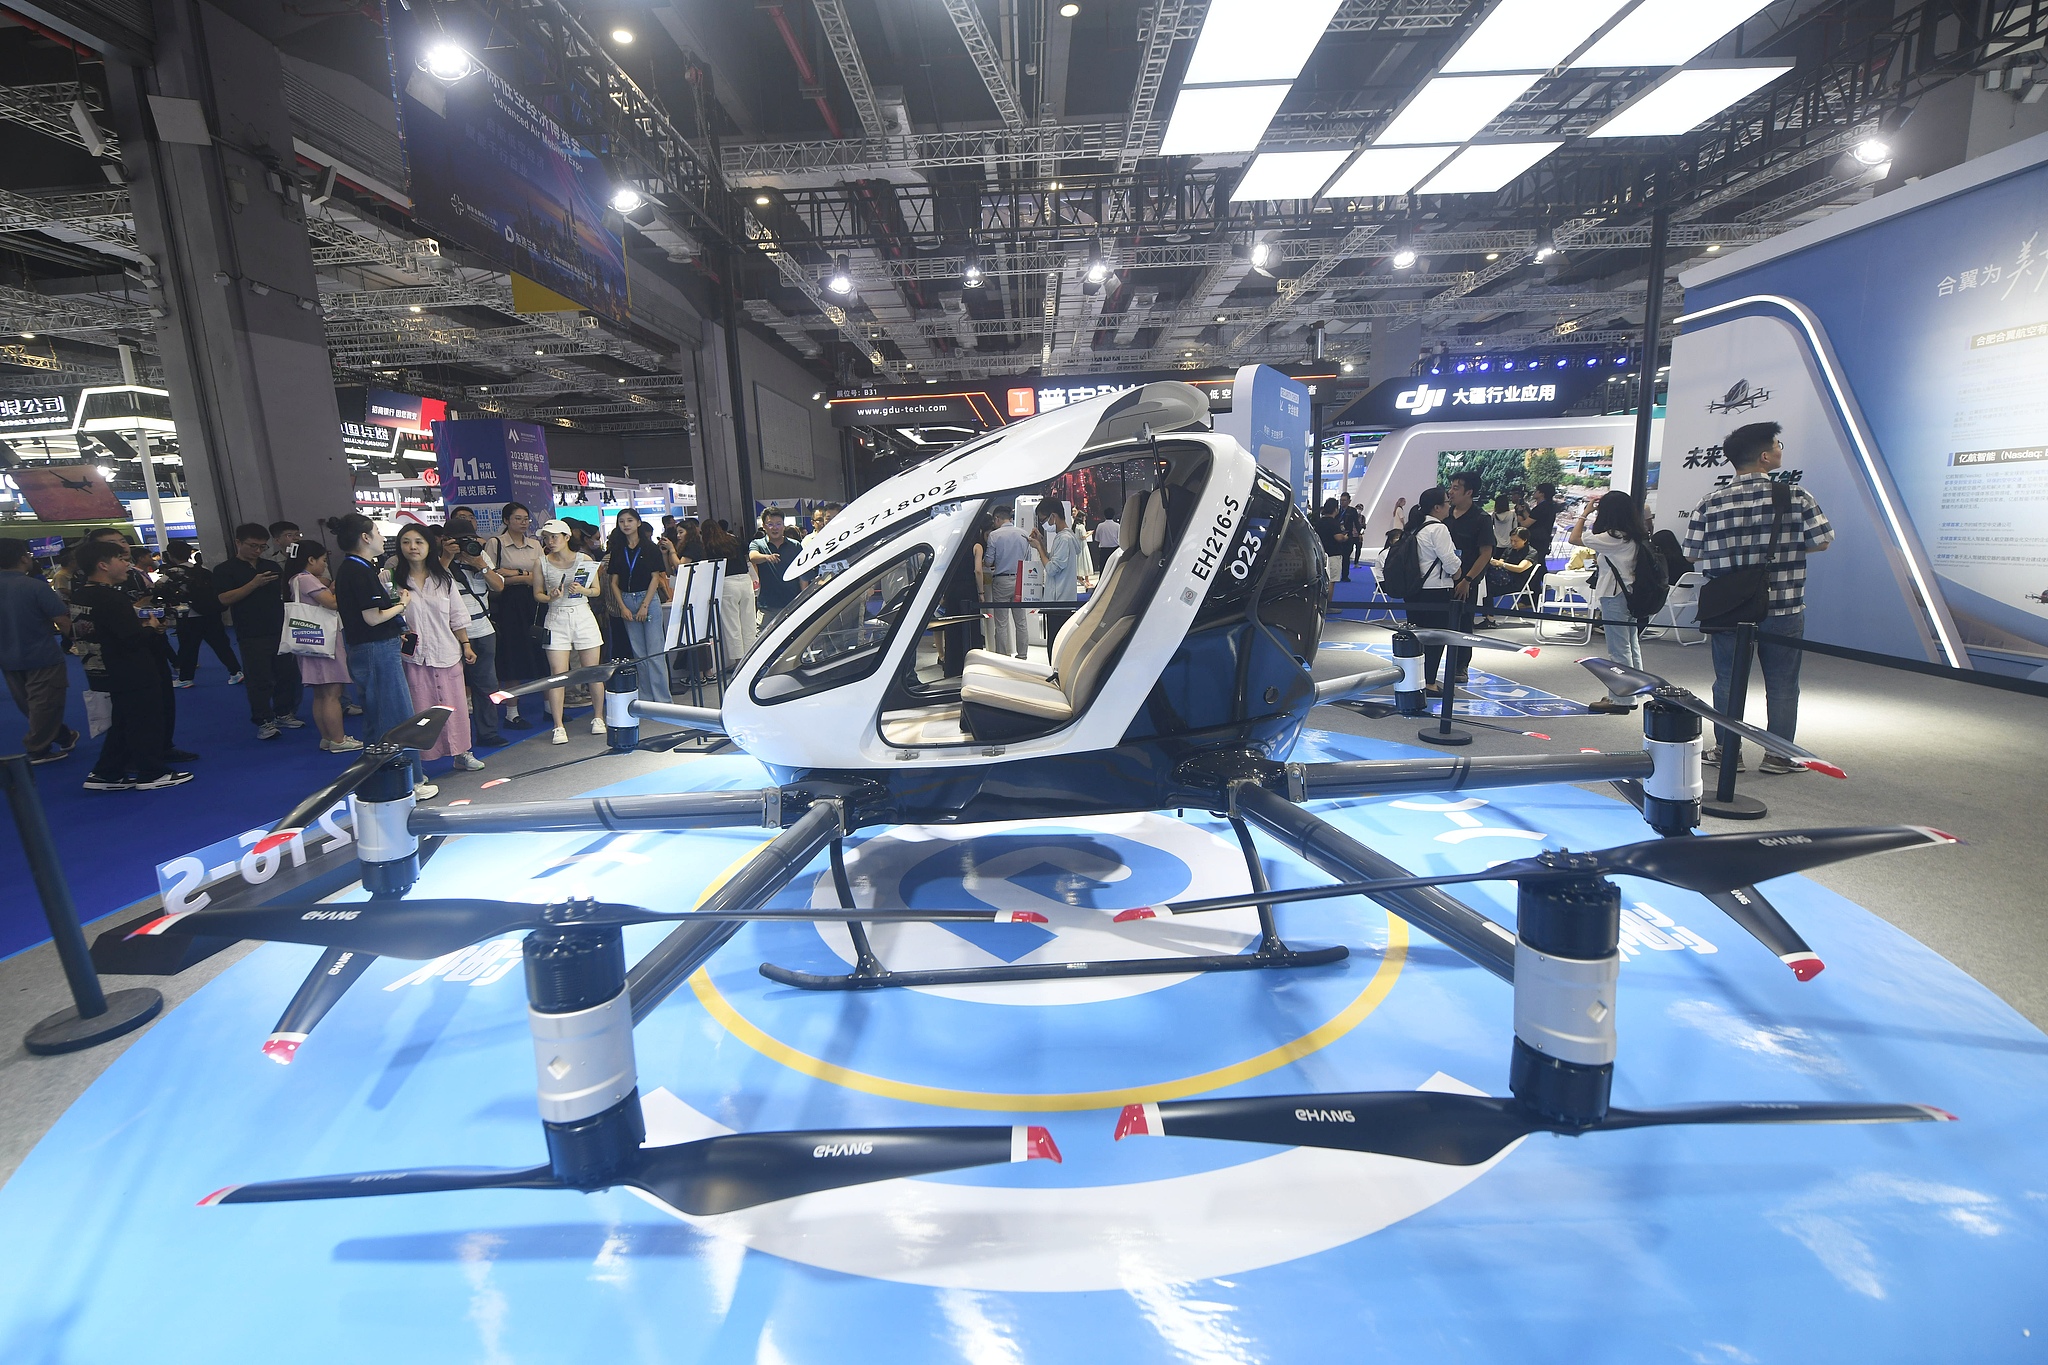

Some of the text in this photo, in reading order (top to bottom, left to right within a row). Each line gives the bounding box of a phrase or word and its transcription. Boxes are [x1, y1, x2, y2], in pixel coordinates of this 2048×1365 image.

[530, 124, 542, 138] Air
[542, 134, 567, 161] Mobility
[567, 154, 583, 172] Expo
[1976, 323, 2048, 347] 合肥合翼航空有
[1209, 388, 1232, 400] 低空
[1452, 384, 1556, 405] 大疆行业应用
[0, 395, 66, 417] 限公司
[857, 404, 947, 416] www.gdu-tech.com
[510, 450, 545, 464] 2025国际低空
[1958, 452, 1996, 464] 亿航智能
[452, 457, 480, 481] 4.1
[479, 462, 492, 470] 号馆
[511, 461, 539, 473] 经济博览会
[480, 470, 497, 479] HALL
[457, 485, 497, 497] 展览展示
[1678, 510, 1690, 518] The
[797, 479, 958, 567] UAS03718002
[1191, 495, 1239, 581] EH216-S
